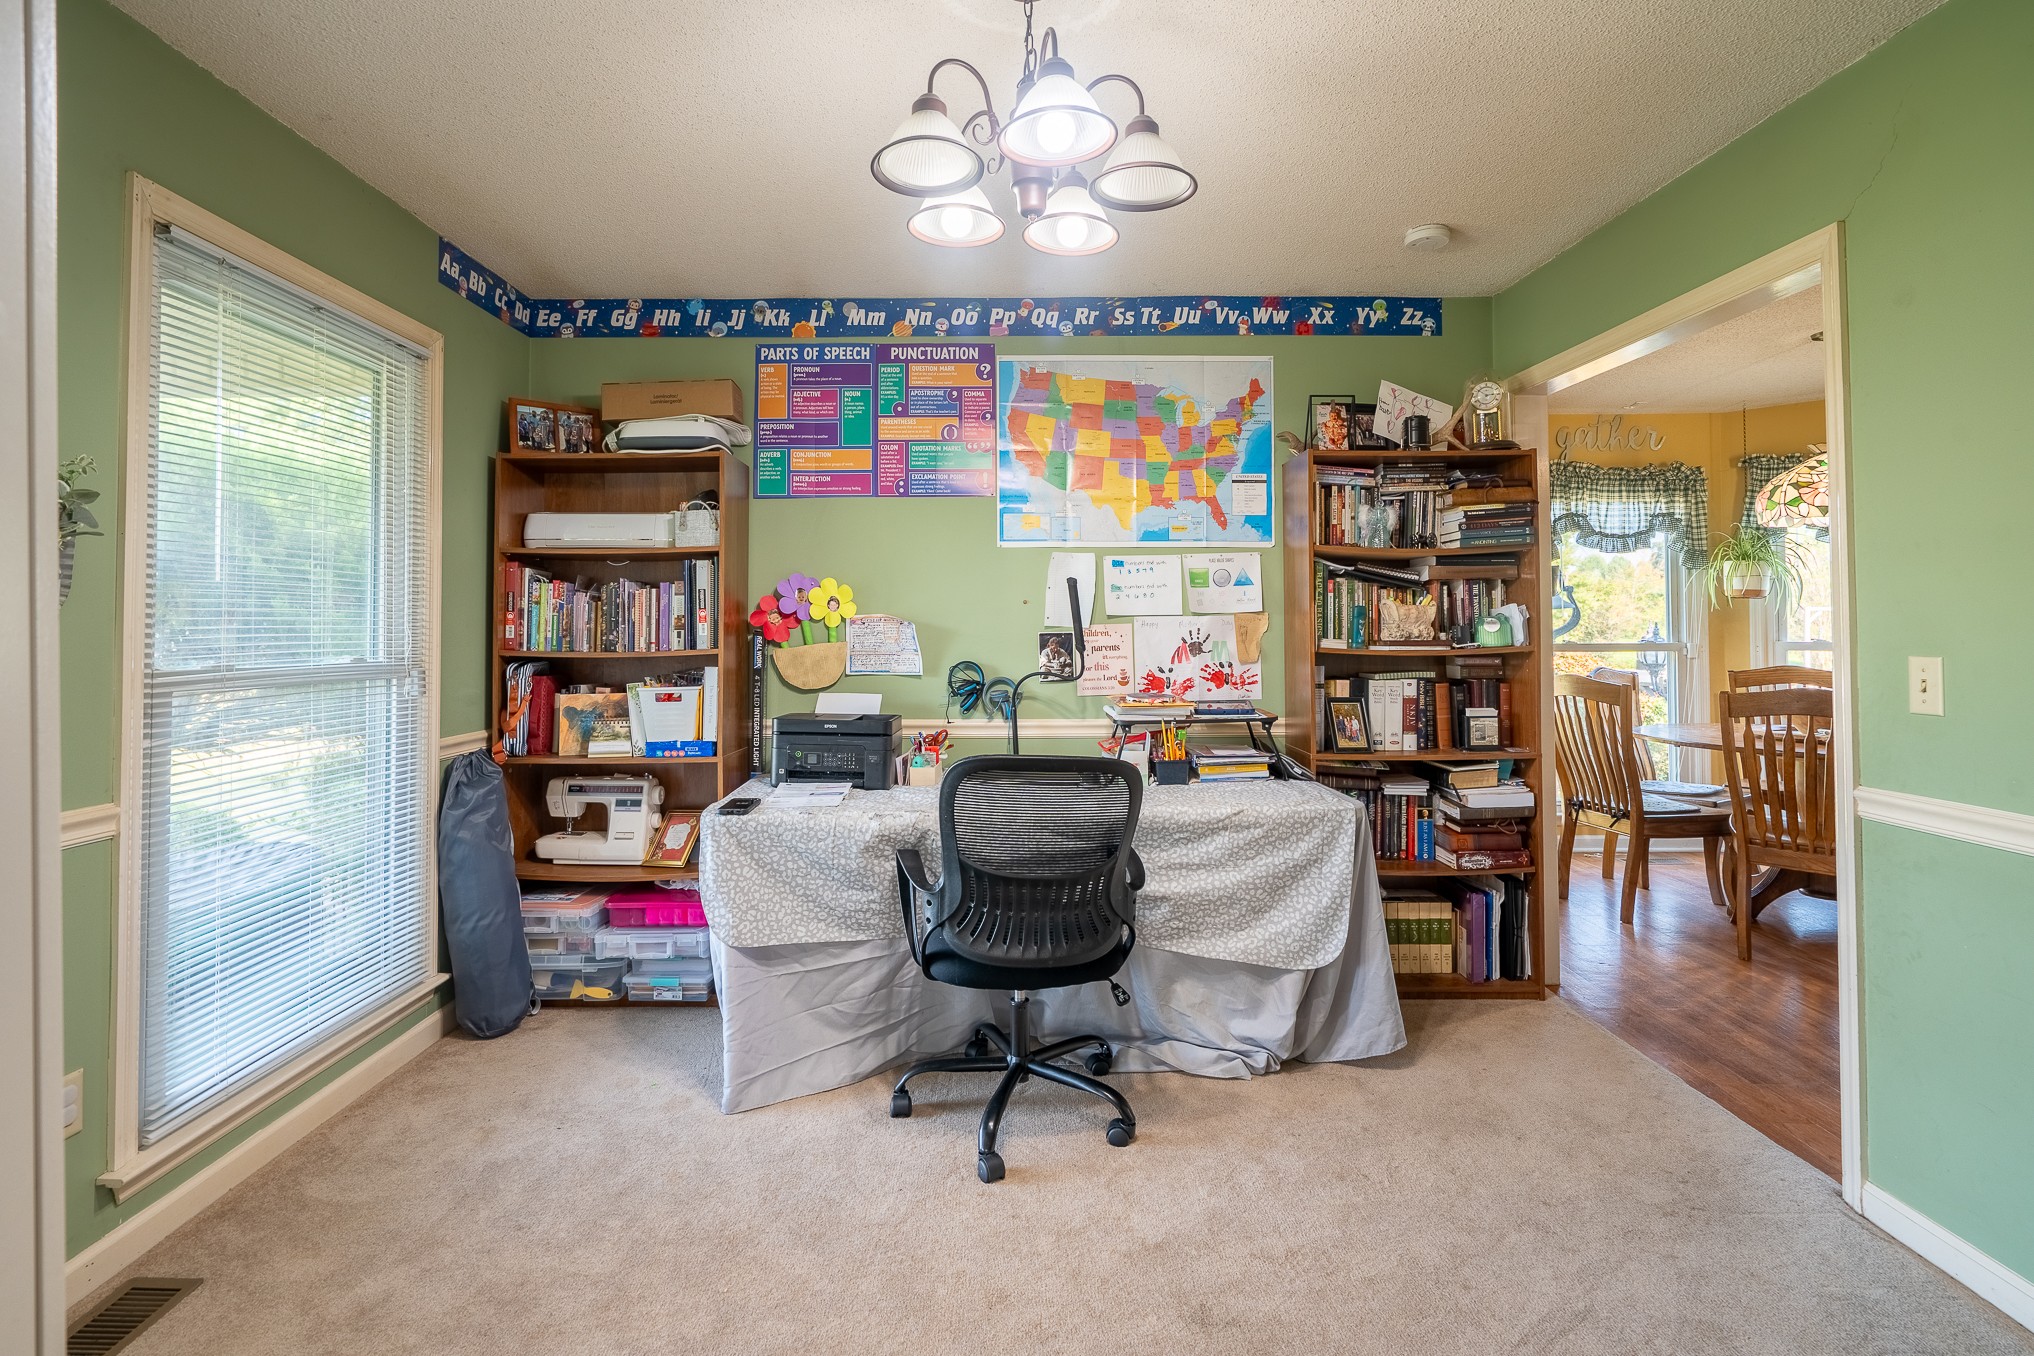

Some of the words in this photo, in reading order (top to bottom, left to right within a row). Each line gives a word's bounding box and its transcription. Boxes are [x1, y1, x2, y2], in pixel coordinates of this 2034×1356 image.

[440, 253, 460, 280] Aa
[469, 270, 487, 296] Bb
[494, 288, 508, 311] Cc
[514, 301, 530, 325] Dd
[537, 309, 561, 327] Ee
[576, 309, 597, 327] Ff
[610, 309, 638, 330] Gg
[653, 309, 682, 327] Hh
[697, 309, 709, 327] Ii
[727, 309, 746, 330] Jj
[763, 309, 791, 327] Kk
[810, 308, 827, 327] Ll
[847, 308, 886, 326] Mm
[904, 308, 932, 326] Nn
[951, 308, 978, 326] Oo
[990, 308, 1016, 328] Pp
[1031, 308, 1060, 328] Qq
[1074, 307, 1099, 325] Rr
[1112, 307, 1135, 325] Ss
[1140, 307, 1161, 325] Tt
[1174, 307, 1201, 325] Uu
[1215, 306, 1239, 325] Vv
[1252, 306, 1290, 325] Ww
[1307, 306, 1335, 325] Xx
[1356, 307, 1379, 328] Yy
[1401, 307, 1422, 325] Zz
[761, 347, 798, 360] PARTS
[804, 347, 819, 360] OF
[824, 347, 870, 360] SPEECH
[891, 347, 979, 360] PUNCTUATION
[1556, 414, 1666, 460] gather
[1317, 596, 1322, 604] TO
[1141, 620, 1159, 628] Happy
[1222, 620, 1233, 630] Day
[1092, 645, 1120, 654] parents
[1094, 662, 1109, 671] this
[1423, 842, 1428, 852] AM
